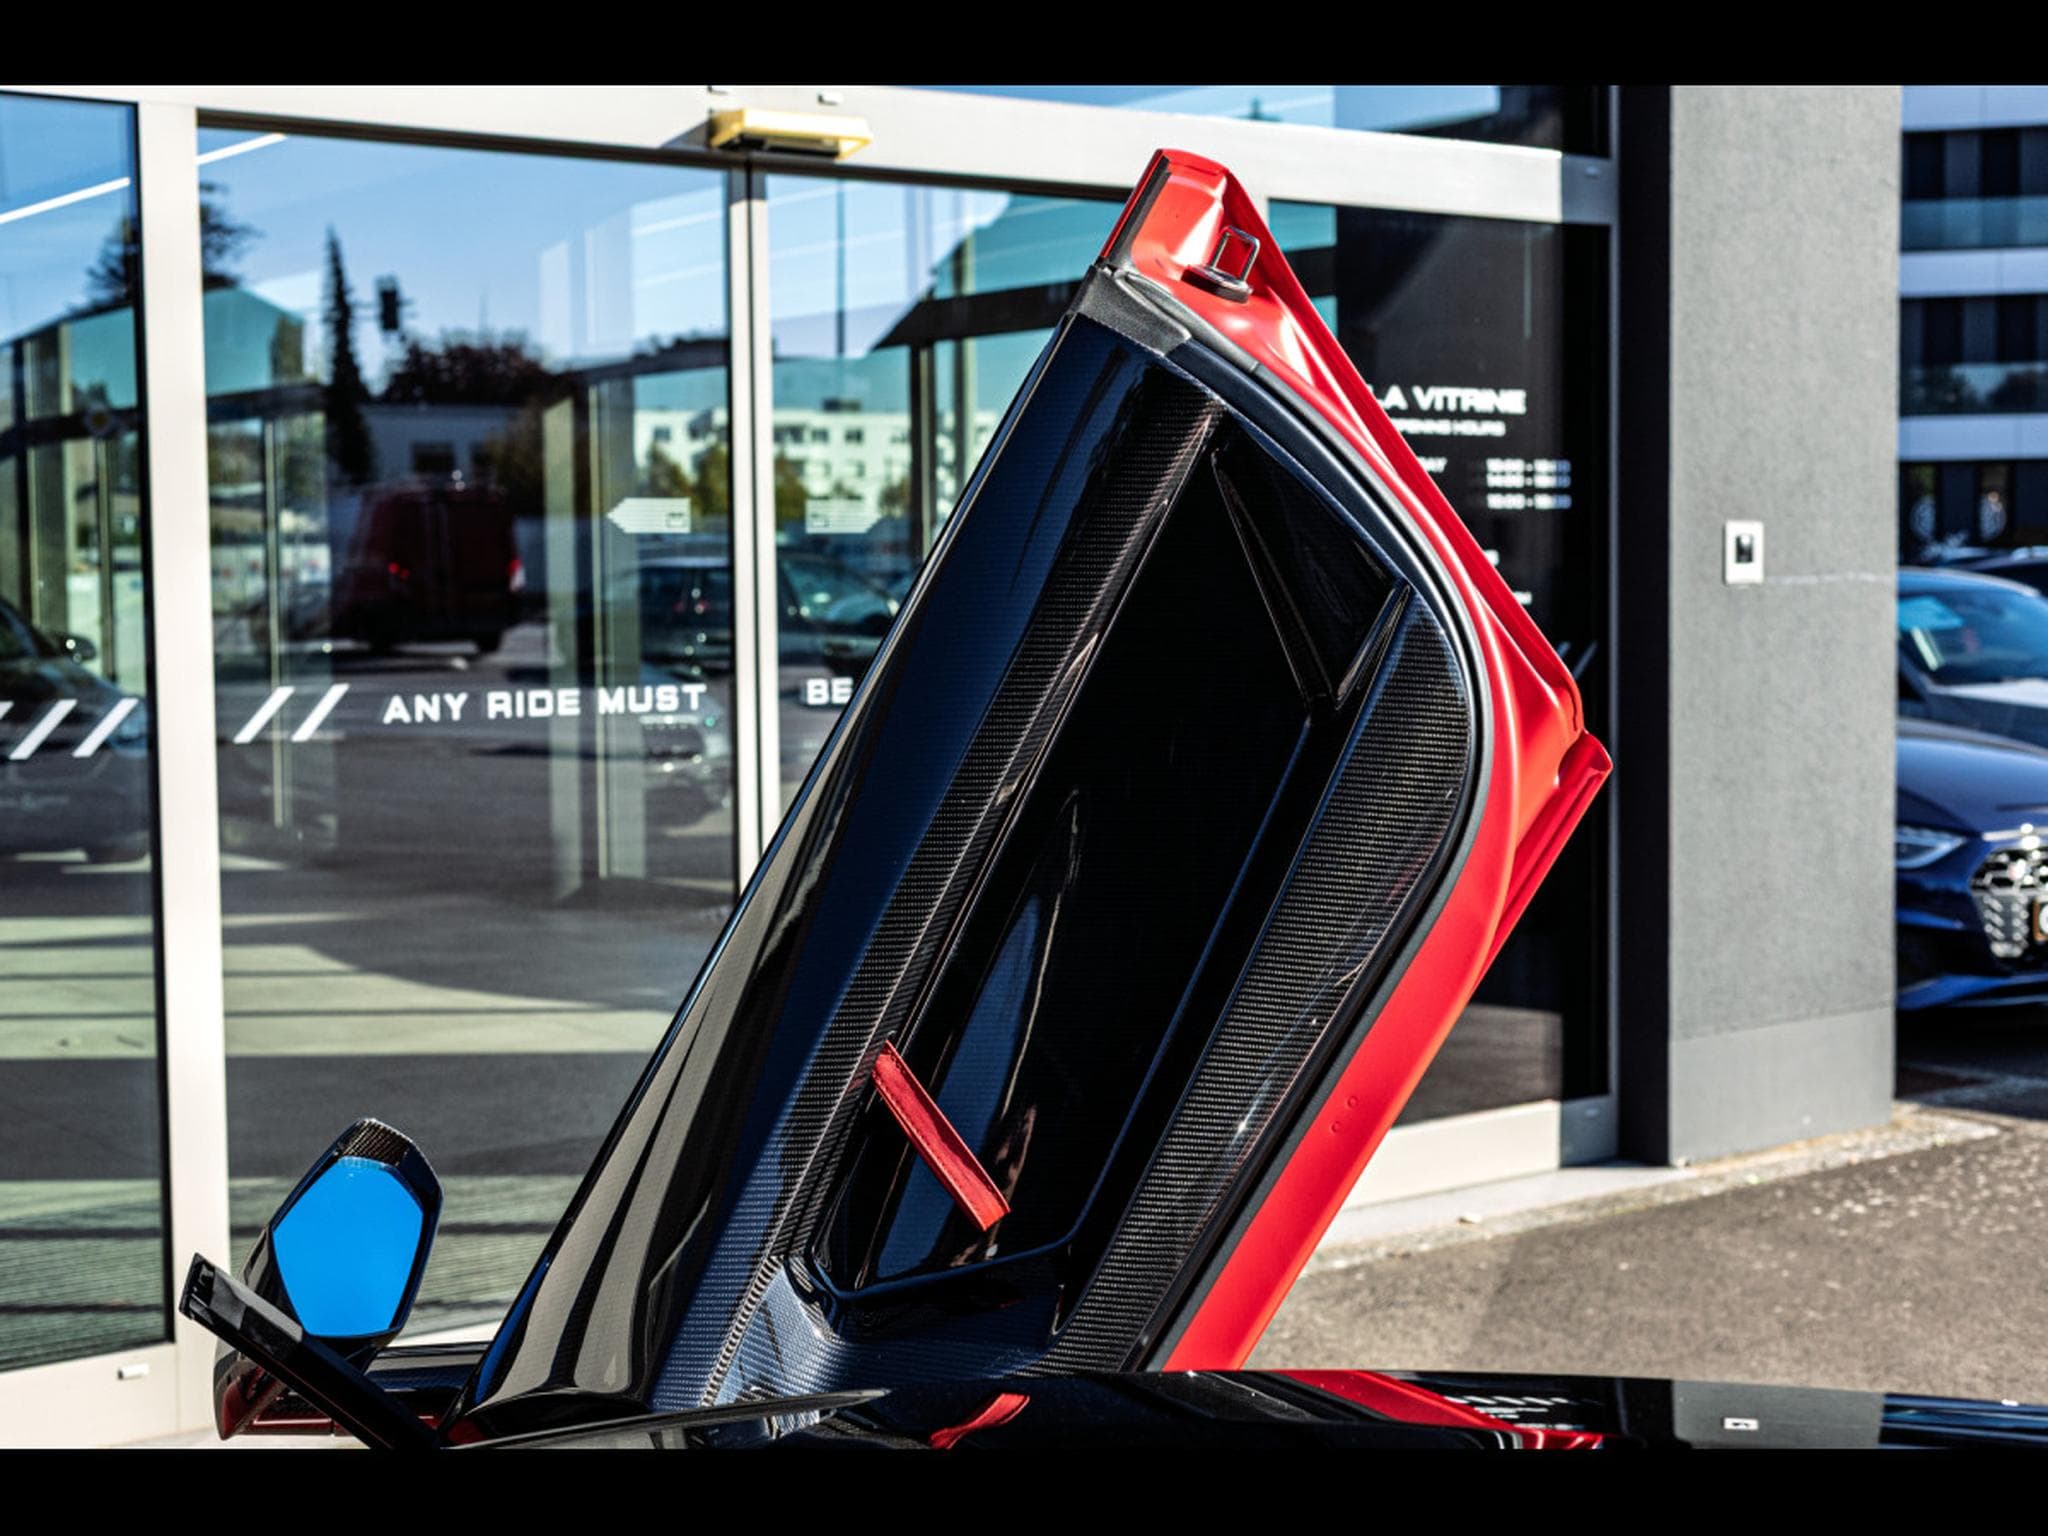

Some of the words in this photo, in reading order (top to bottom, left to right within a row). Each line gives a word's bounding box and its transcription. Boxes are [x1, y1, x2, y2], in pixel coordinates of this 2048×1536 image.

[1412, 385, 1527, 415] VITRINE
[382, 692, 468, 724] ANY
[487, 688, 581, 720] RIDE
[597, 683, 707, 715] MUST
[806, 677, 853, 705] BE
